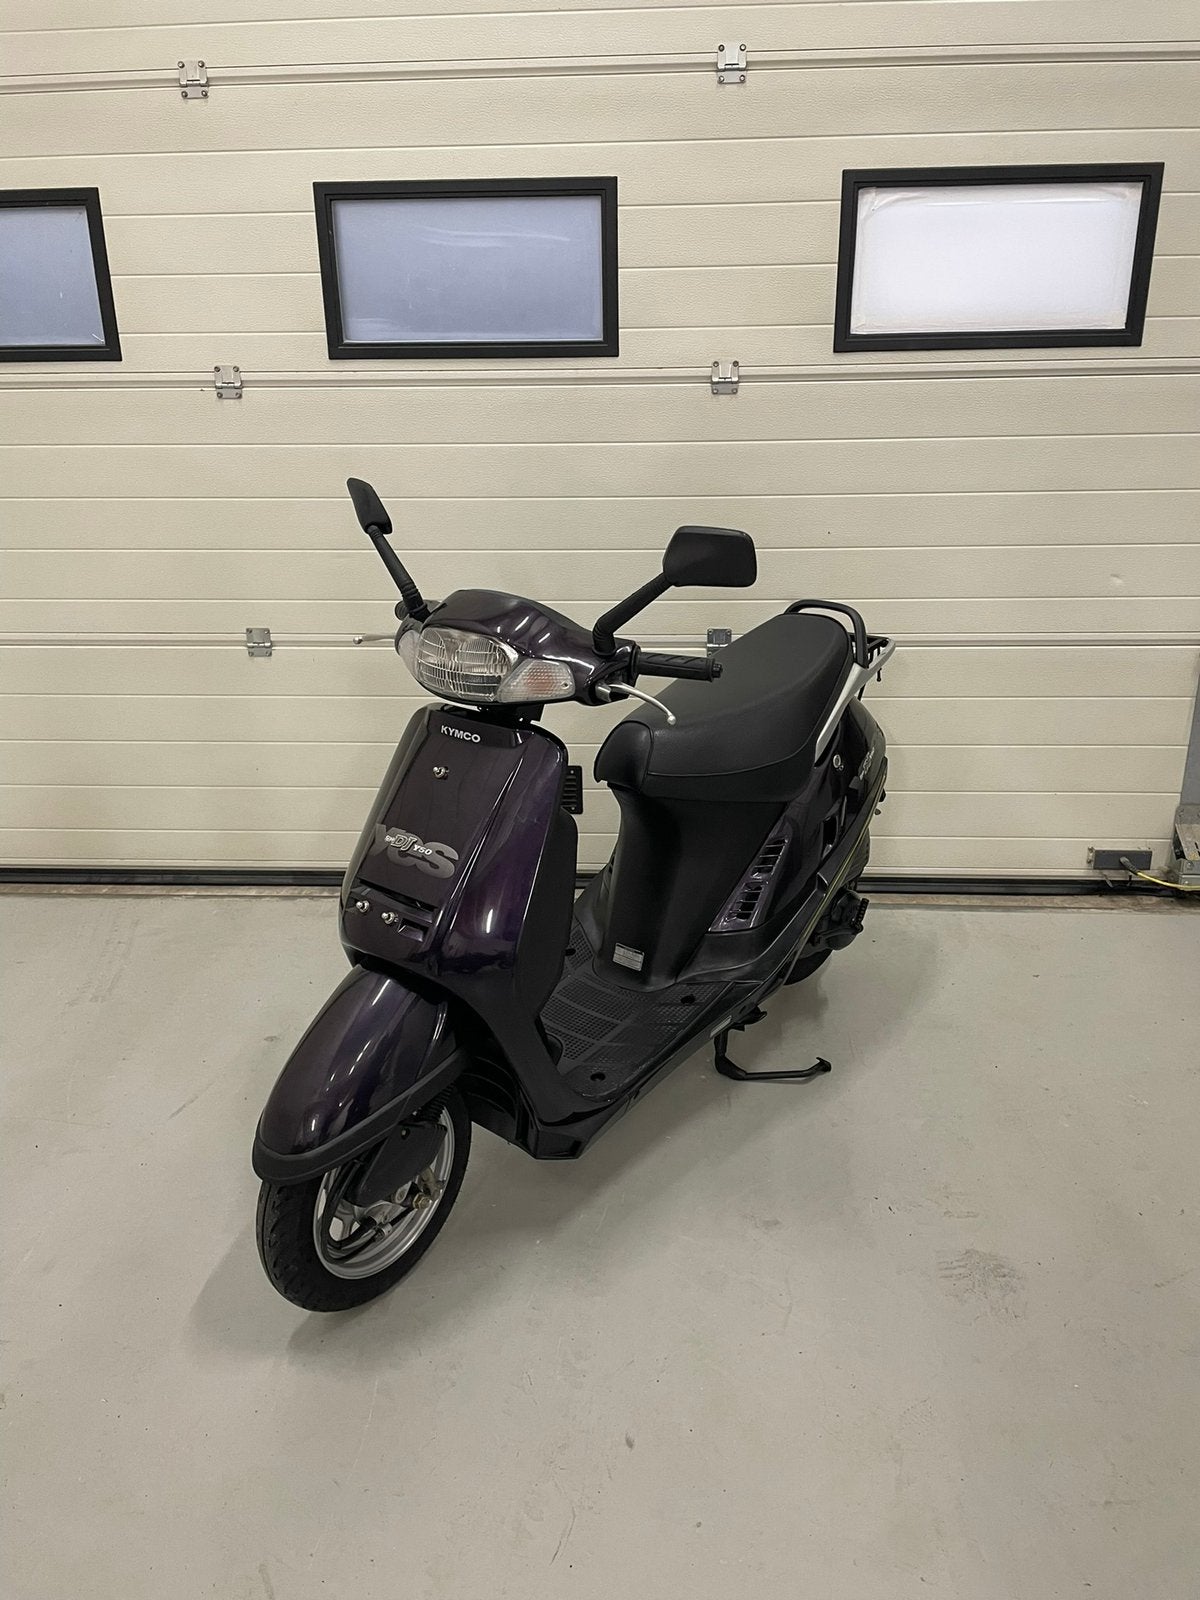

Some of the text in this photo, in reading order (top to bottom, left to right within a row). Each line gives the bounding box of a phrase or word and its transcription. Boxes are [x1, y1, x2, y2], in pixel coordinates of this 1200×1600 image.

[440, 725, 481, 743] KYMCO
[390, 834, 418, 851] DJ
[413, 844, 433, 856] Y50
